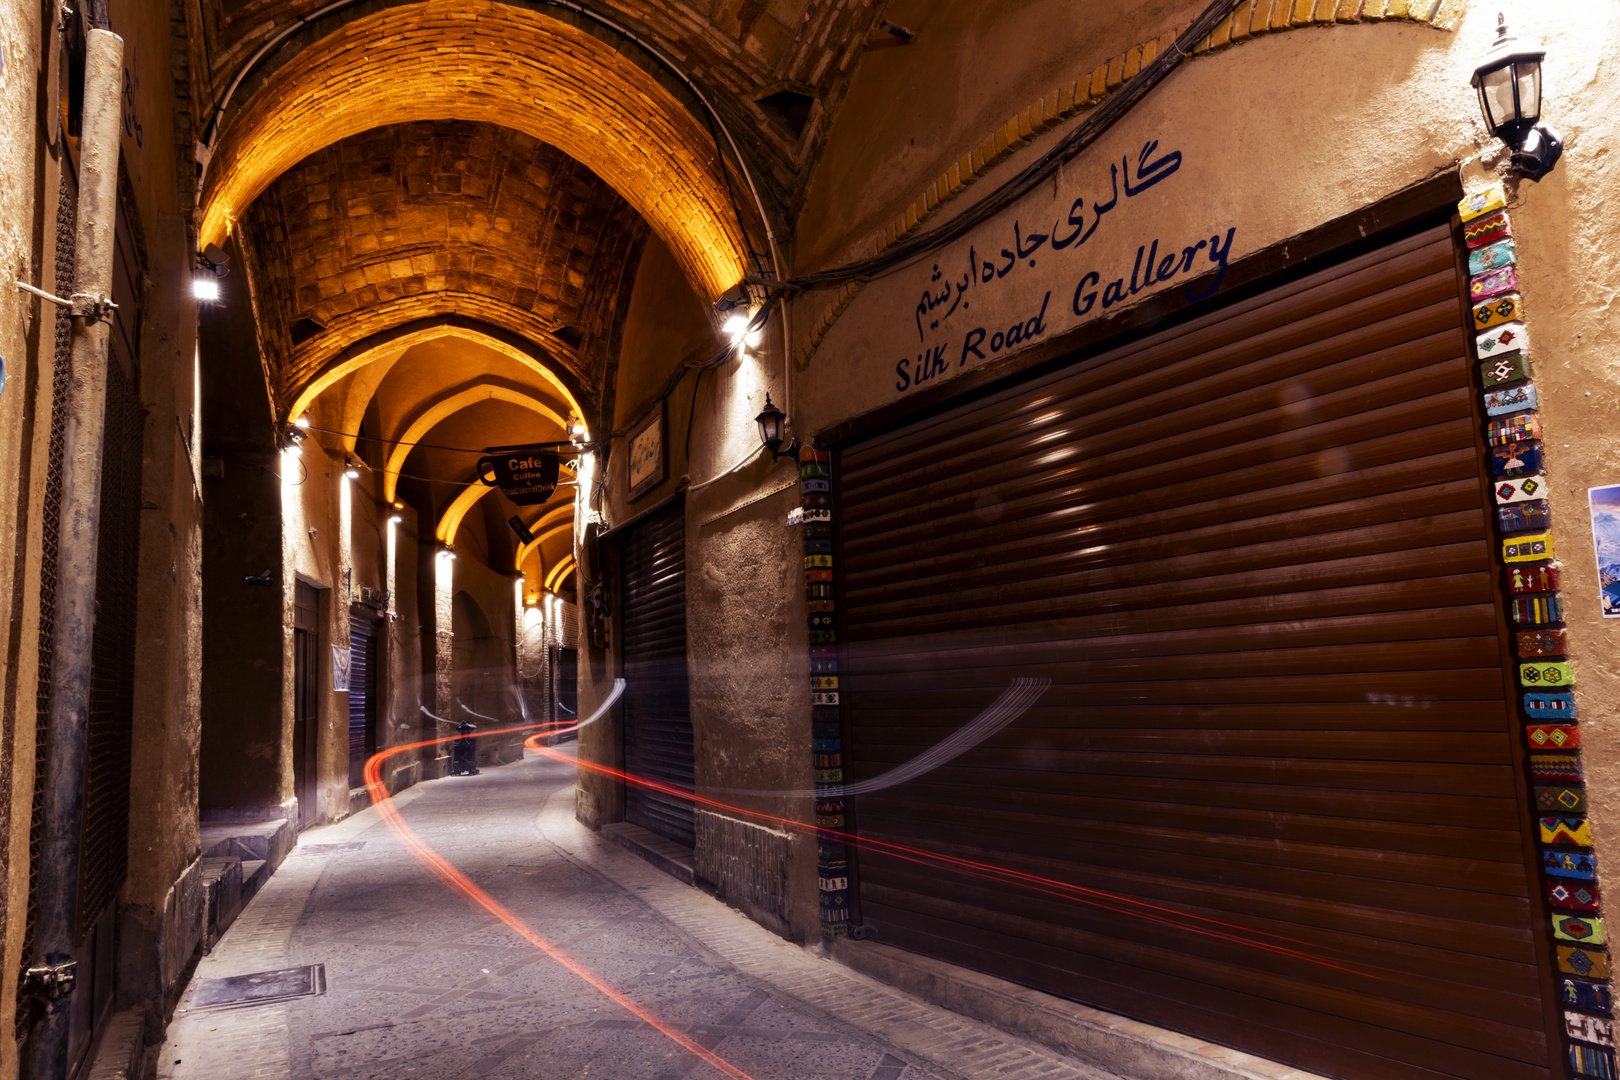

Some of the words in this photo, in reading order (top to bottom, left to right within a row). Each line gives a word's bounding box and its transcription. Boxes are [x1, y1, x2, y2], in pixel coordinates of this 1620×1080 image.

[1051, 139, 1183, 250] گالری
[915, 245, 977, 343] ابریشم
[982, 221, 1049, 284] جاده
[895, 342, 950, 392] Silk
[959, 290, 1051, 367] Road
[1072, 227, 1237, 316] Gallery
[513, 472, 541, 481] Coffee
